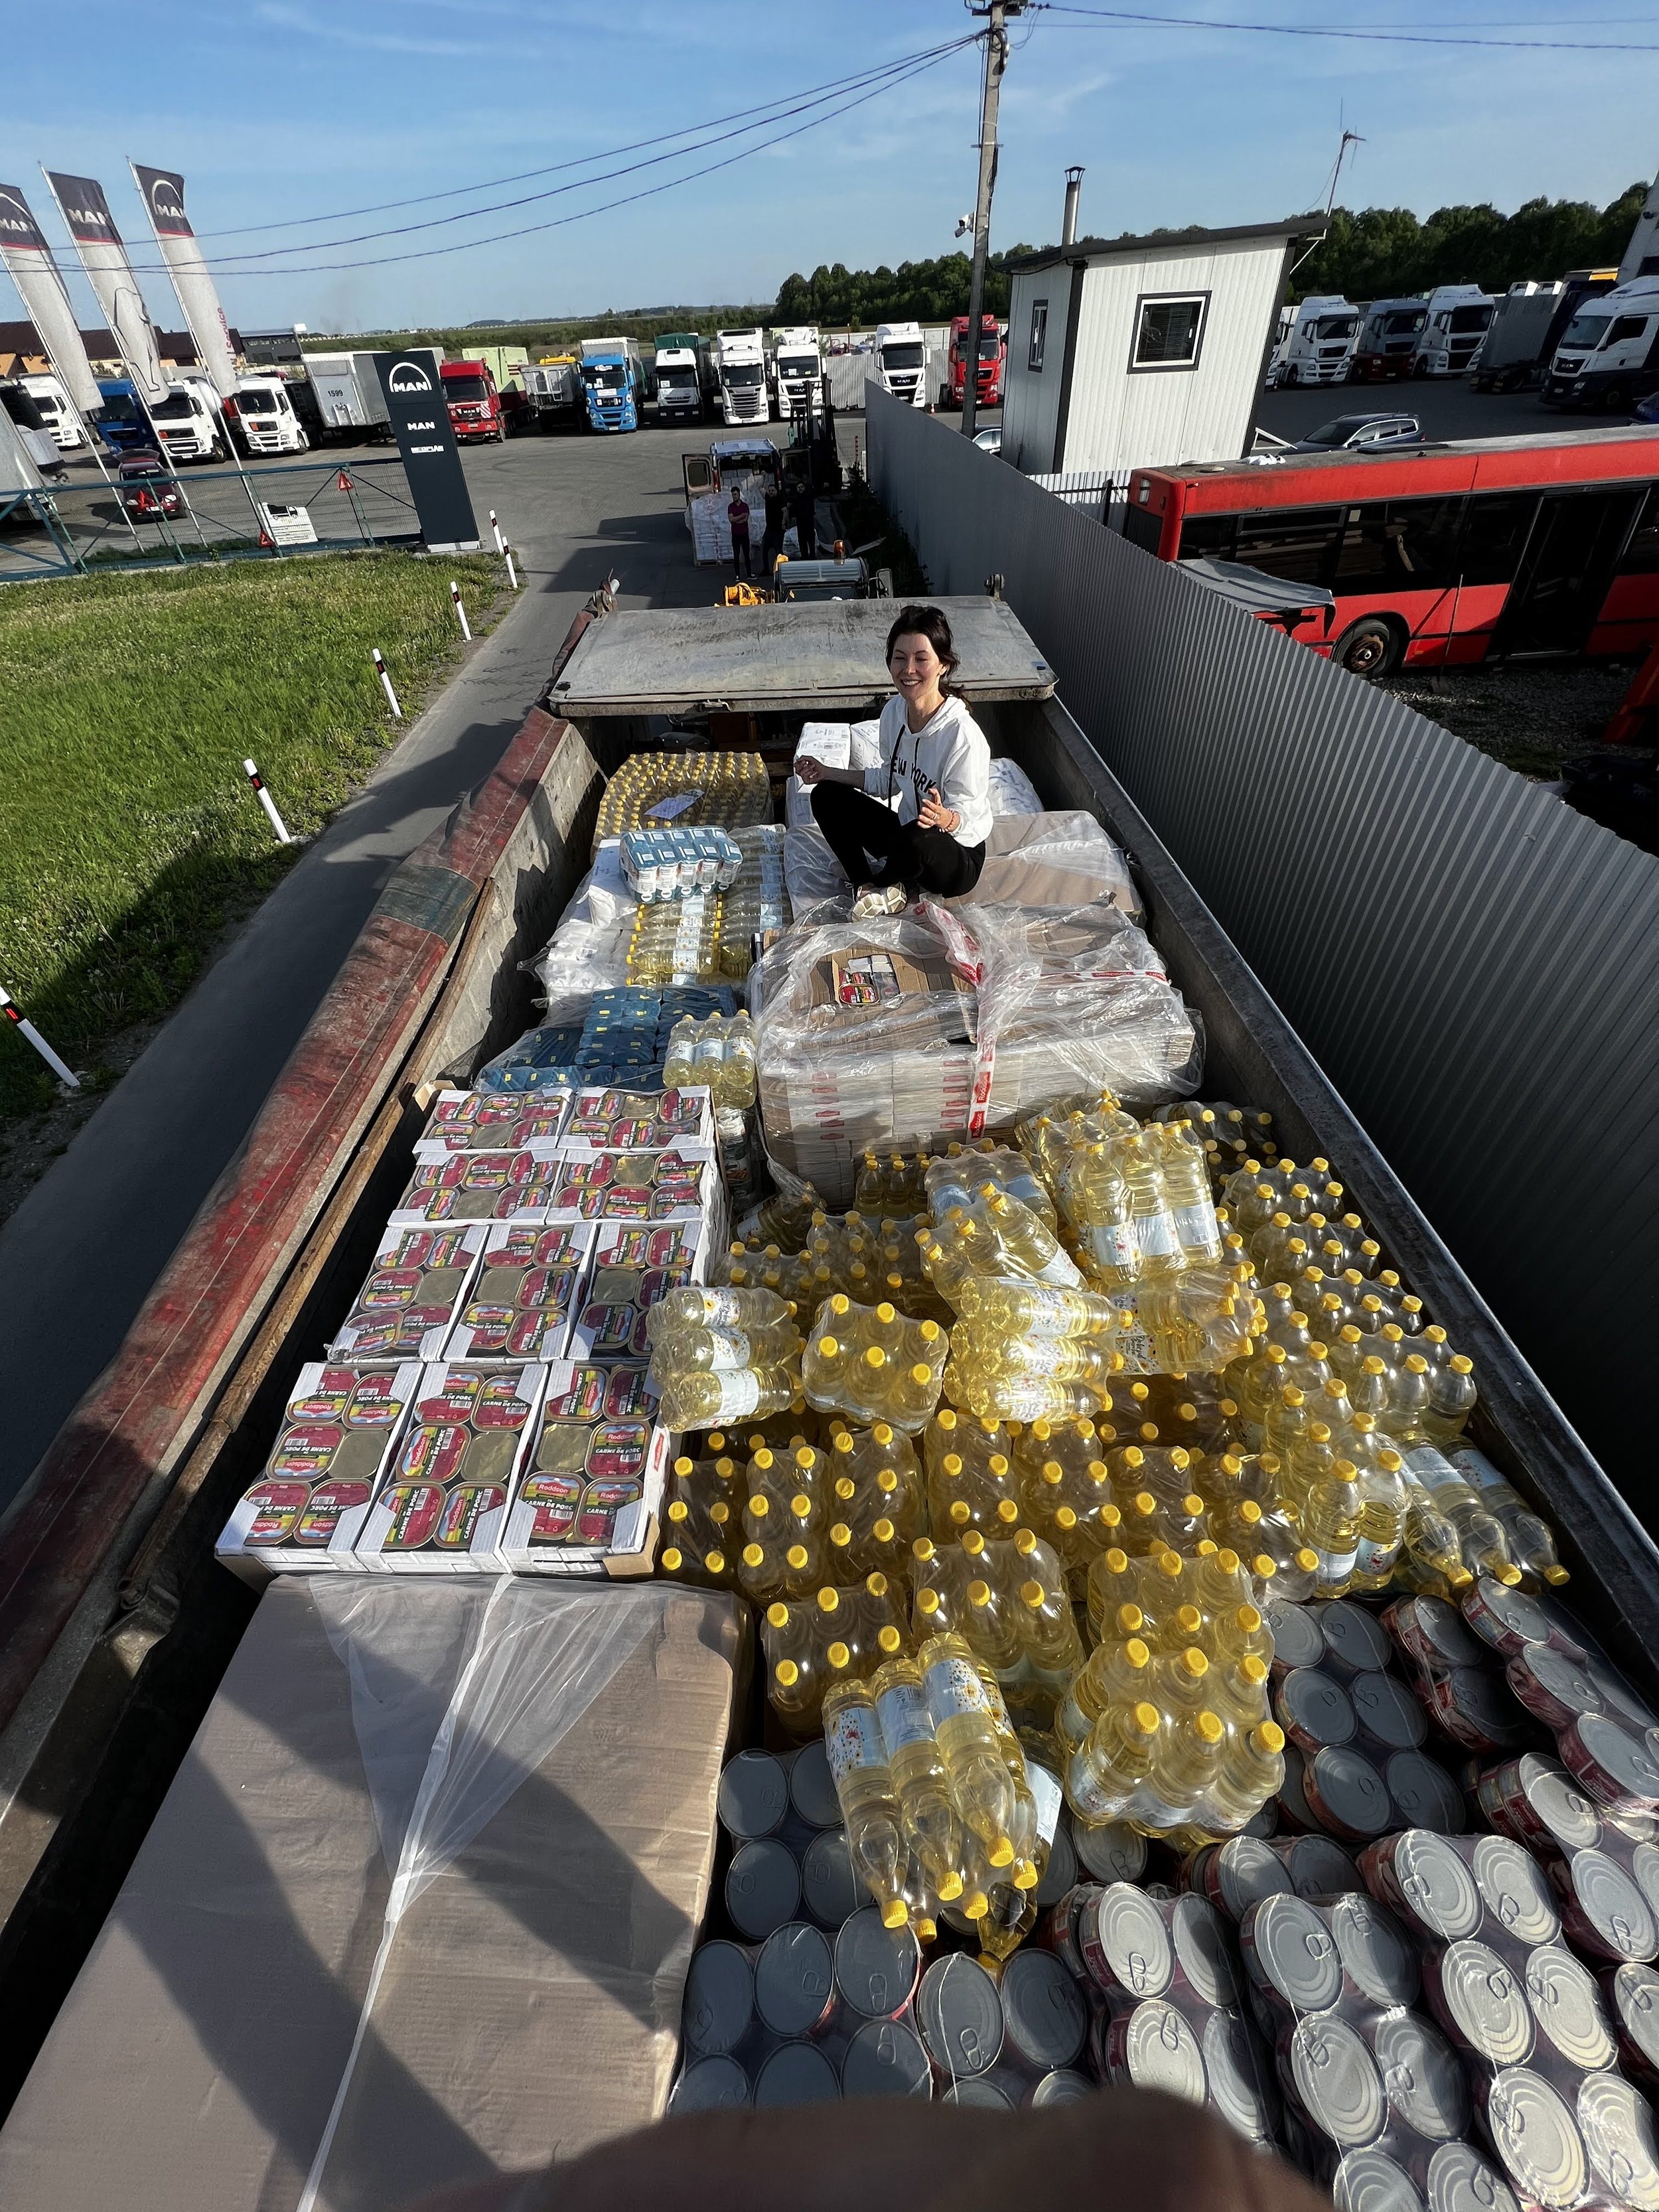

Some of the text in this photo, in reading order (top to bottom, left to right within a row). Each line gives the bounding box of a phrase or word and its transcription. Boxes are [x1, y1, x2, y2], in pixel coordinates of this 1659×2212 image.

[394, 381, 428, 392] MAN
[407, 421, 435, 431] MAN
[890, 756, 907, 776] EW
[585, 1381, 597, 1408] Roddson
[412, 1436, 427, 1465] Roddson
[425, 1455, 437, 1475] CARNE
[436, 1429, 446, 1447] PORC
[539, 1484, 568, 1493] Roddson
[398, 1517, 411, 1539] CARNE
[410, 1490, 421, 1508] PORC
[449, 1499, 464, 1529] Roddson
[463, 1517, 476, 1539] CARNE
[474, 1490, 483, 1508] PORC
